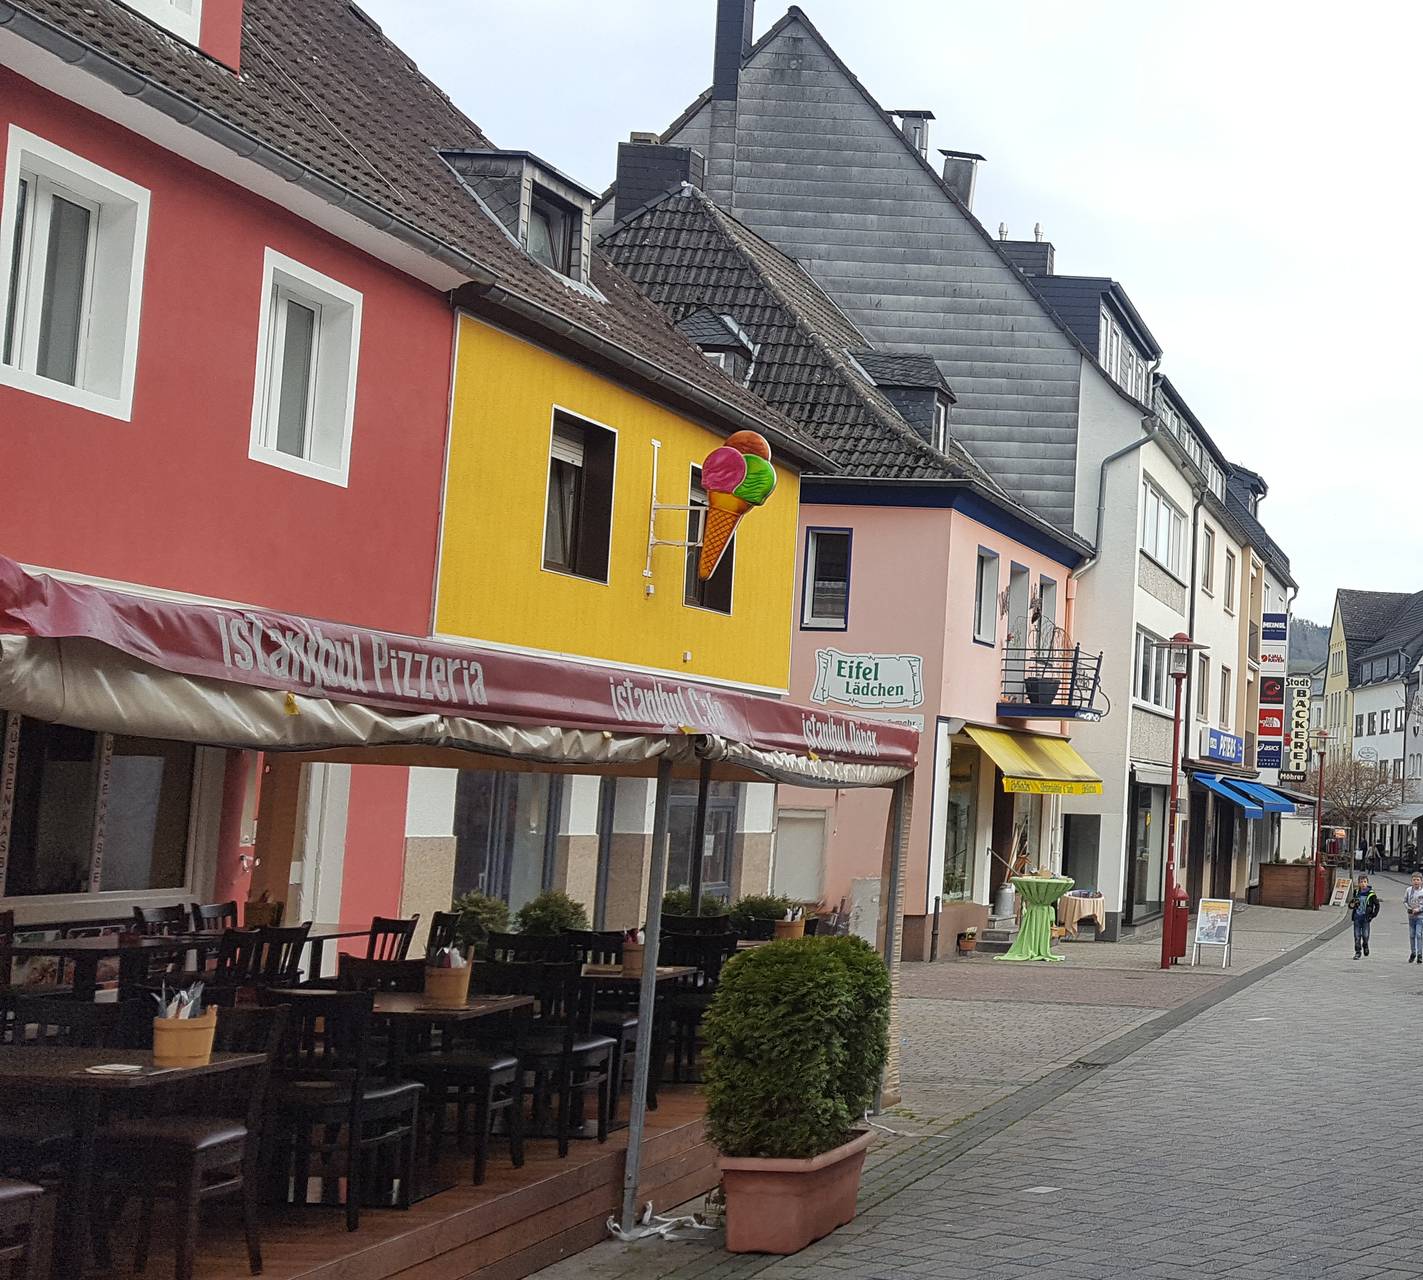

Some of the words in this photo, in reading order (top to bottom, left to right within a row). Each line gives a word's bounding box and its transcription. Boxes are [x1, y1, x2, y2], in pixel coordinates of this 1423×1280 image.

[369, 634, 488, 706] Pizzeria
[836, 660, 879, 681] Eifel
[845, 681, 905, 697] Lädchen
[1285, 677, 1310, 687] Stadt
